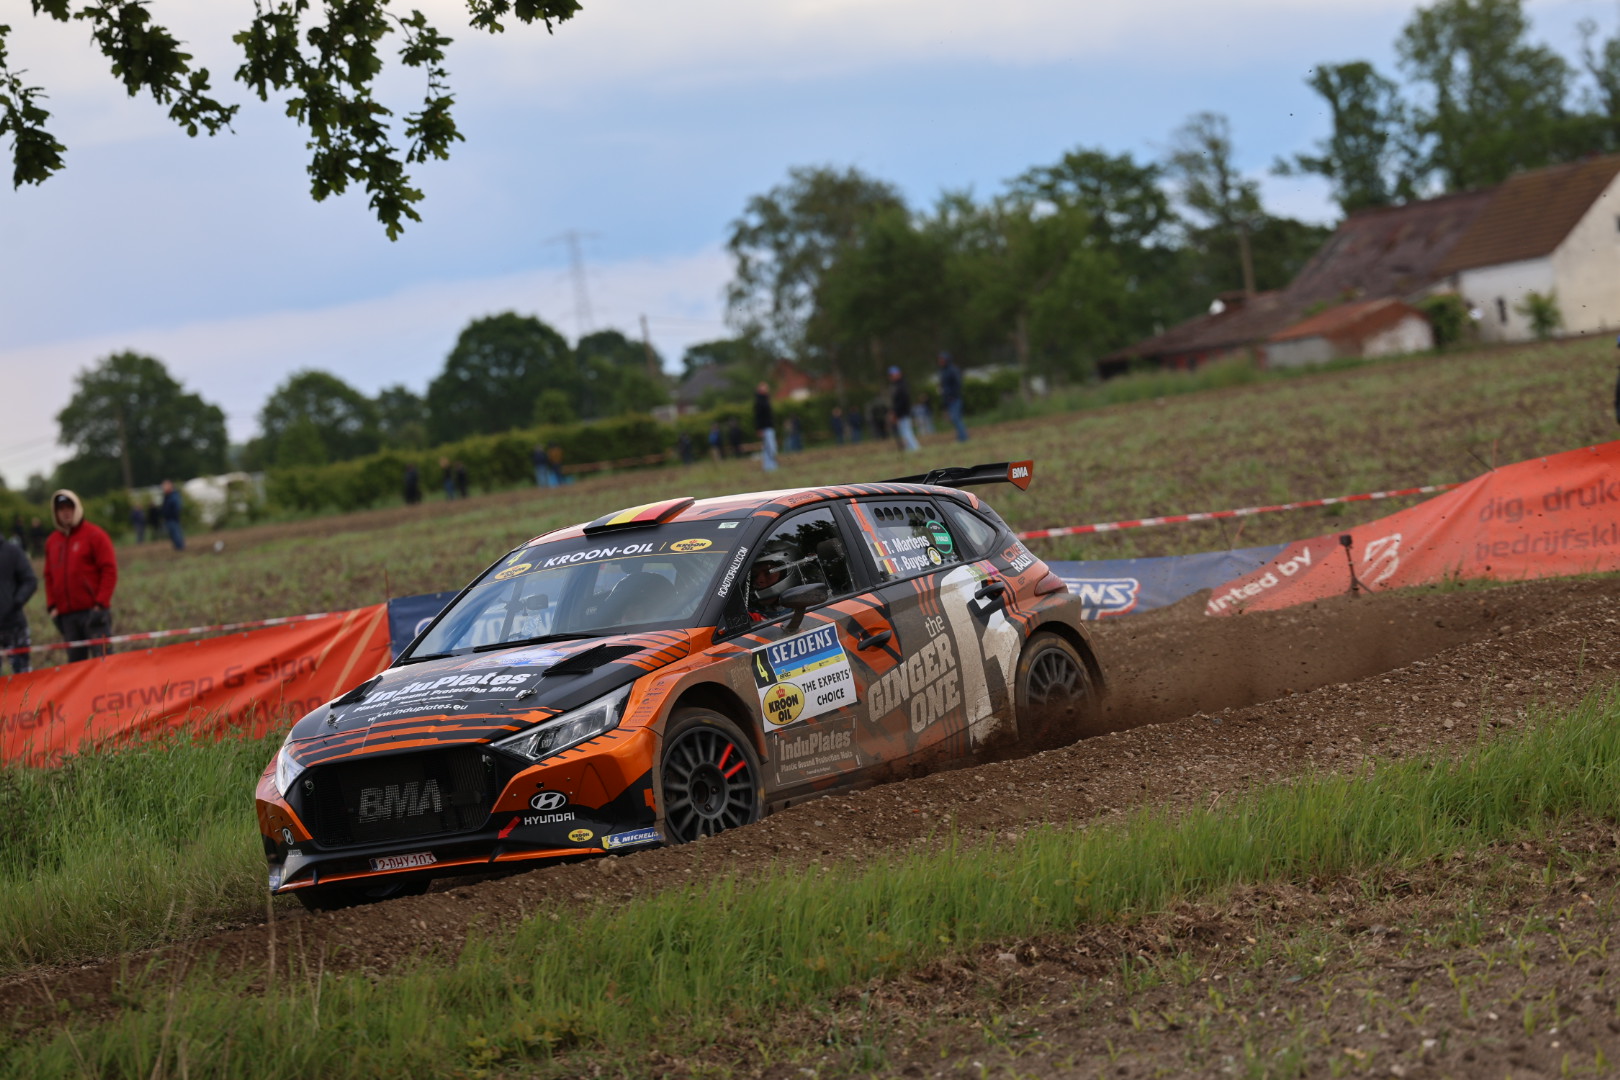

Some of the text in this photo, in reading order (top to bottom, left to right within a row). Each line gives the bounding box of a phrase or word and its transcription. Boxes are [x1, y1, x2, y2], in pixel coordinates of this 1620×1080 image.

[1012, 466, 1029, 479] BMA
[1479, 479, 1620, 523] dig. druk
[543, 542, 654, 568] KROON-OIL
[882, 534, 931, 555] T. Martens
[1475, 523, 1620, 562] bedrijfskl
[891, 553, 930, 573] T. Buyse
[1010, 553, 1033, 573] RALLY
[1065, 582, 1131, 606] ENS
[1204, 546, 1312, 616] inted by
[925, 616, 945, 637] the
[772, 629, 833, 664] SEZOENS
[756, 653, 770, 683] 4
[801, 680, 816, 694] THE
[818, 667, 852, 687] EXPERTS'
[868, 633, 956, 722] GINGER
[91, 654, 317, 715] carwrap & sign
[361, 671, 532, 706] InduPlates
[817, 688, 845, 706] CHOICE
[768, 694, 799, 713] KROON
[911, 668, 961, 734] ONE
[778, 709, 792, 722] OIL
[780, 730, 851, 761] InduPlates
[359, 779, 443, 820] BMA
[524, 812, 575, 825] HYUNDAI
